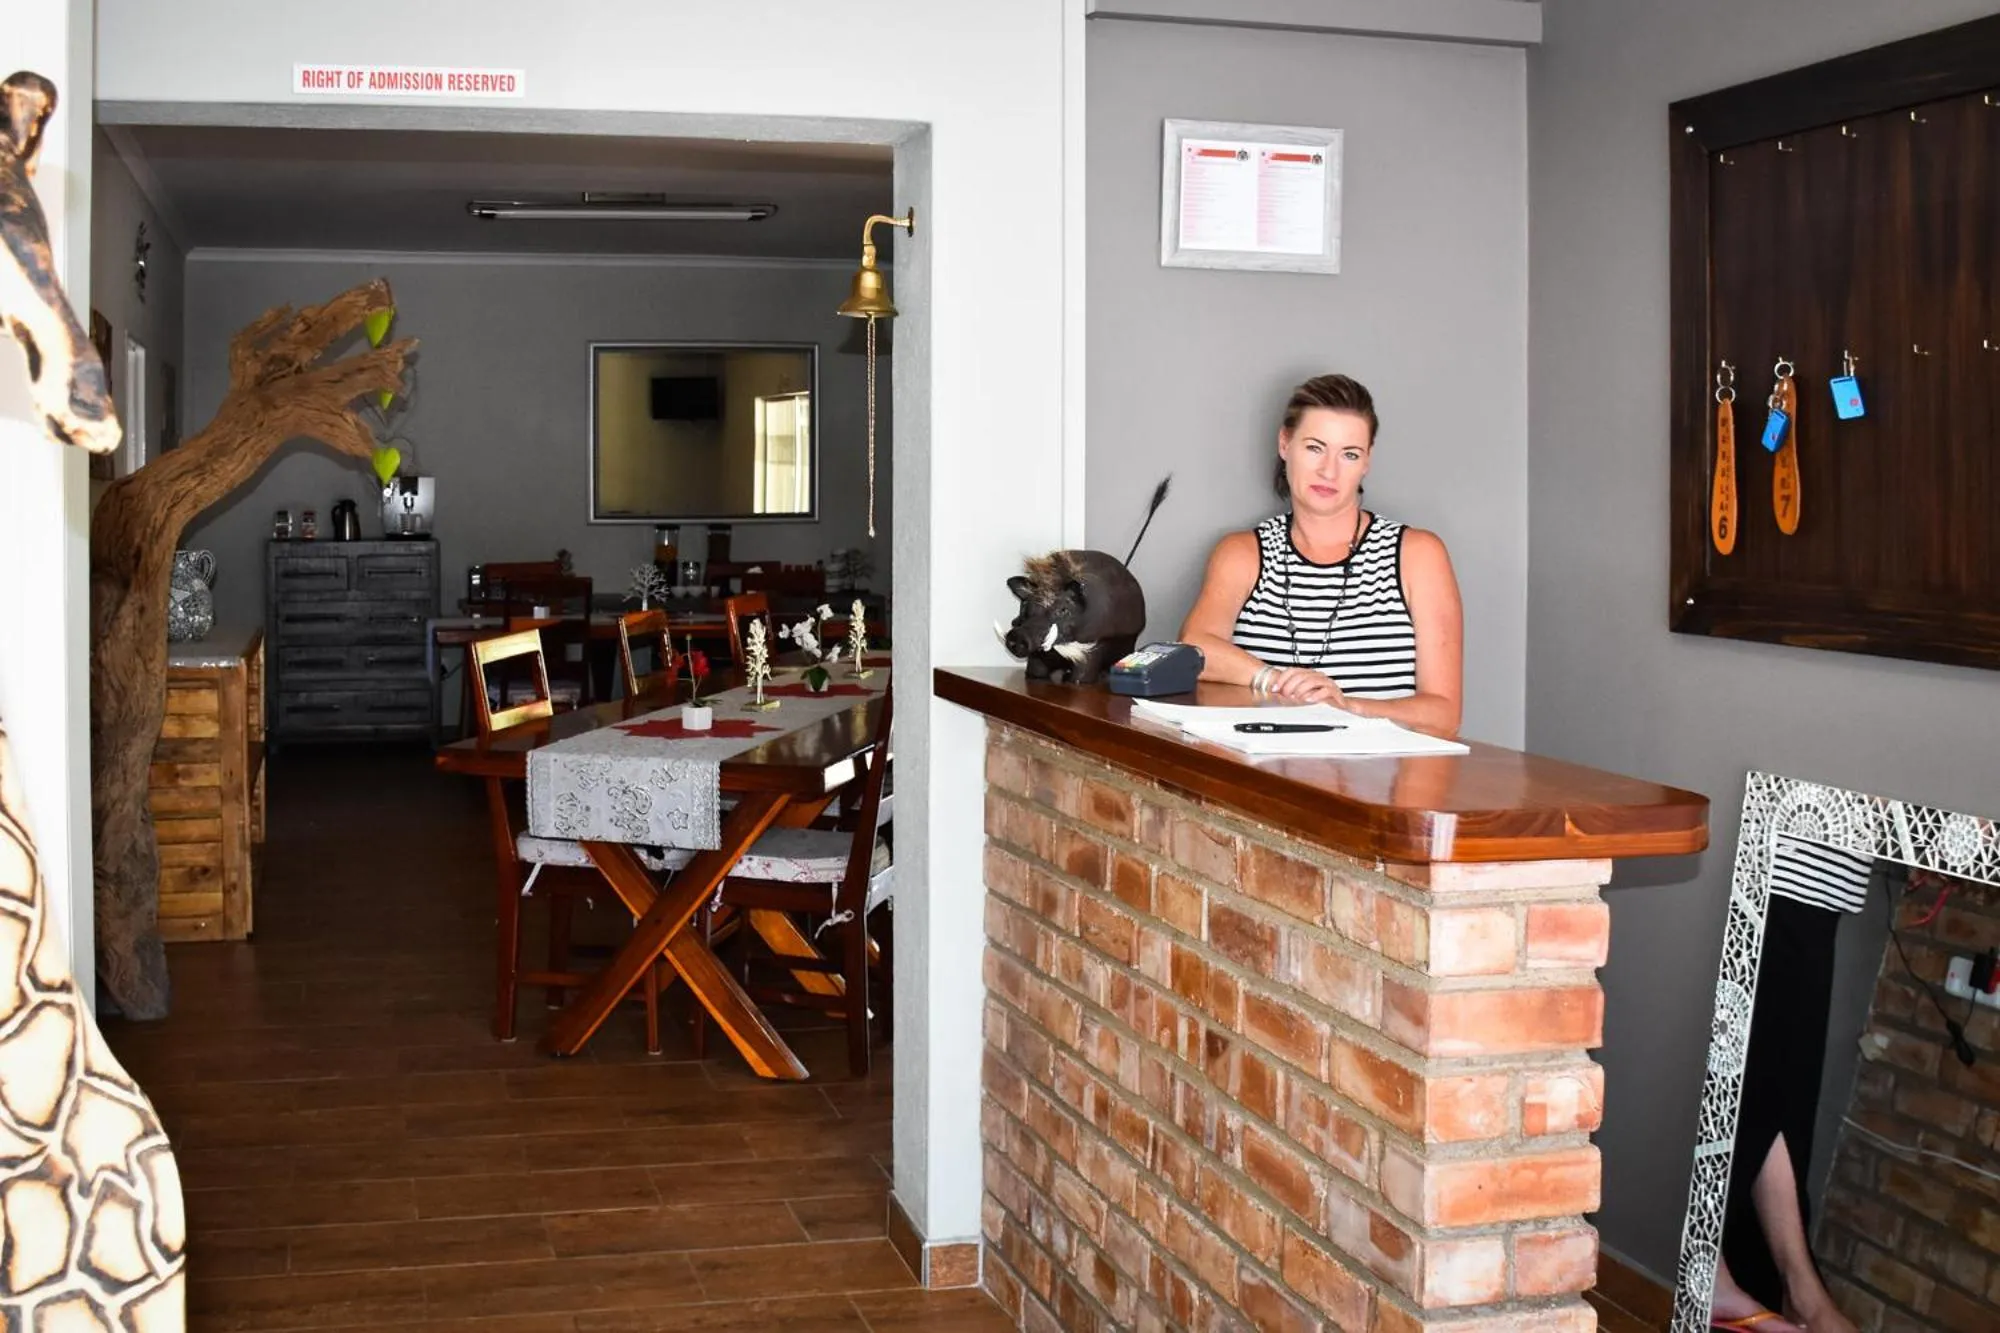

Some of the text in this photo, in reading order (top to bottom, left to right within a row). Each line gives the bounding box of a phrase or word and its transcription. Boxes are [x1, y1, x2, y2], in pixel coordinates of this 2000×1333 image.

[302, 69, 516, 92] RIGHT OF ADMISSION RESERVED
[1780, 495, 1791, 518] 7
[1718, 515, 1728, 540] 6
